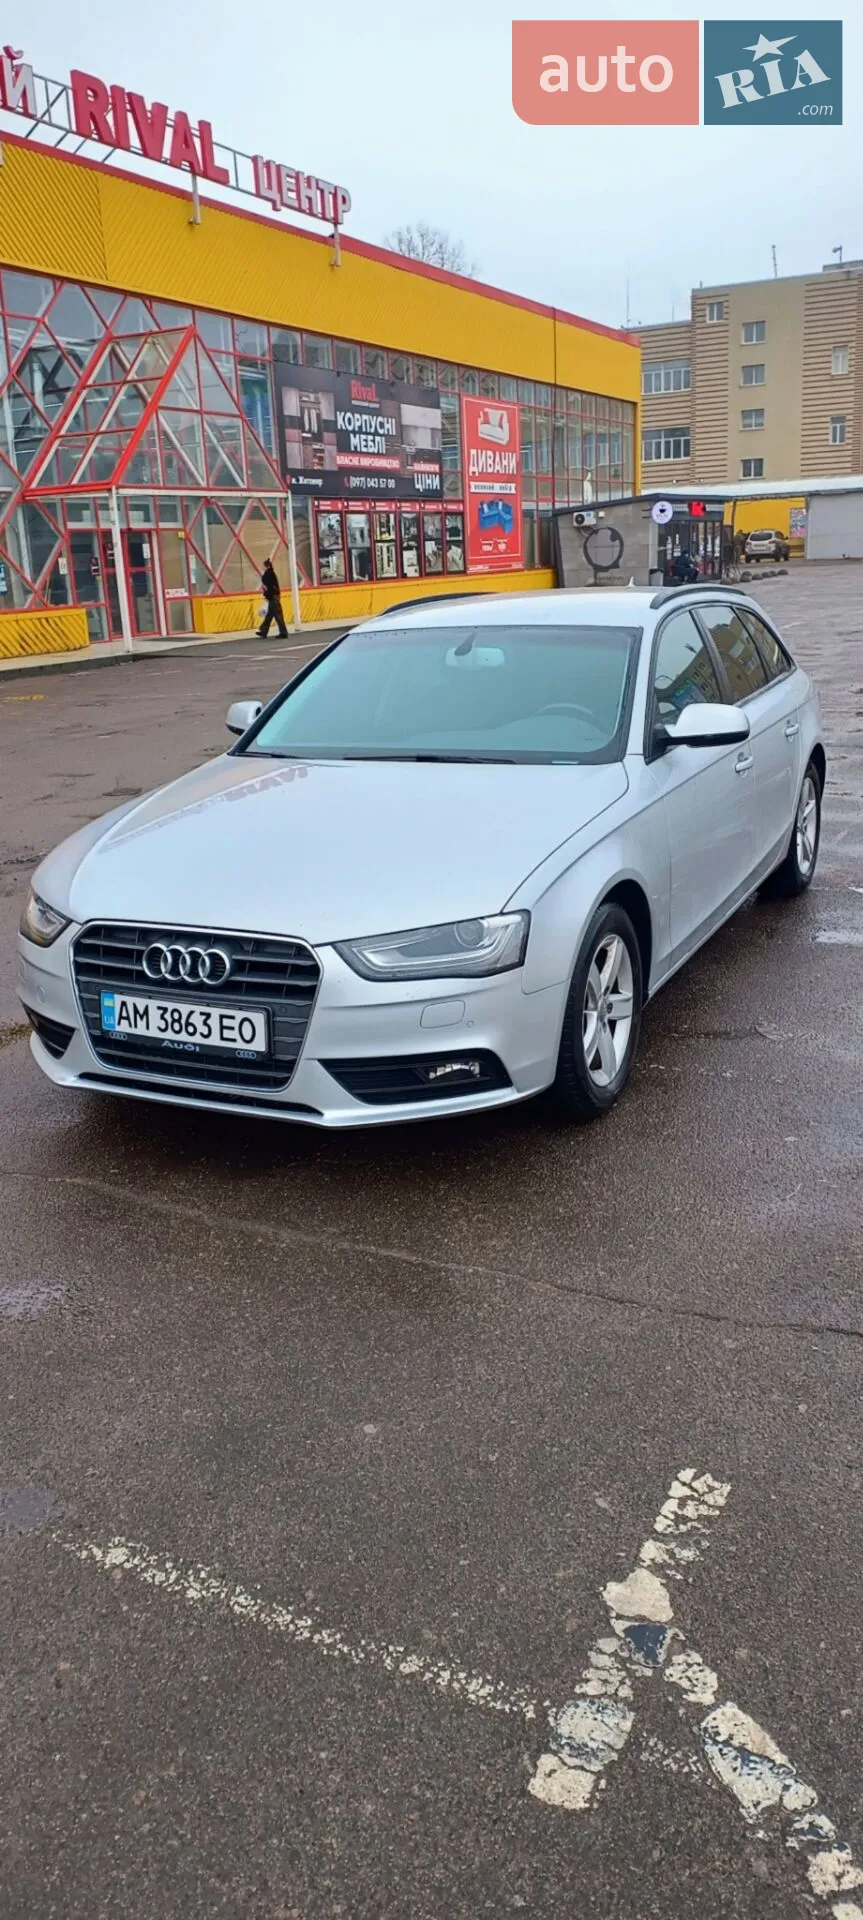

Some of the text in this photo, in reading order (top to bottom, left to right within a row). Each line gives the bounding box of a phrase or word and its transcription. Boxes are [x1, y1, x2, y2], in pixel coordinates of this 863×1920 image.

[70, 69, 230, 185] RIVAL
[252, 154, 352, 225] ЦЕНТР
[336, 411, 396, 436] КОРПУСНІ
[350, 433, 386, 454] МЕБЛІ
[469, 448, 516, 476] ДИВАНИ
[350, 477, 395, 489] (097) 043 57 00
[414, 472, 440, 492] ЦІНИ
[104, 1000, 256, 1044] UA AM 3863 EO
